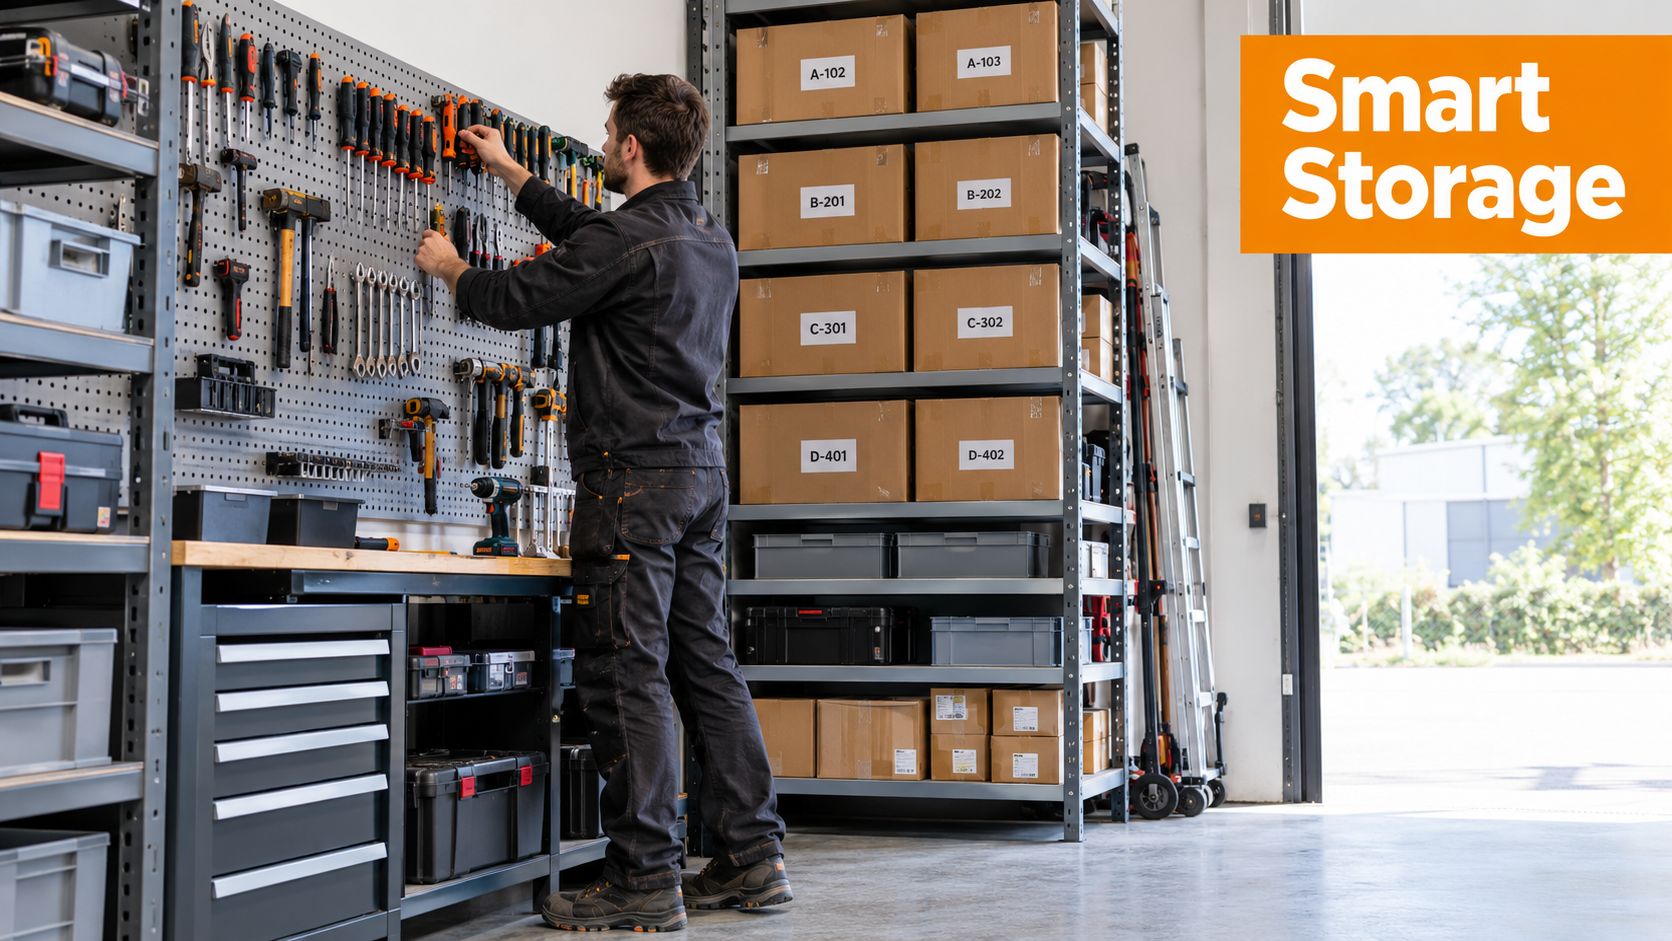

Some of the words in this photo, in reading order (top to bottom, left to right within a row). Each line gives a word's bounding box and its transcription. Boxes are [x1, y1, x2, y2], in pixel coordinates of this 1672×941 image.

[967, 56, 1001, 69] A-103
[810, 66, 846, 80] A-102
[967, 188, 1001, 200] B-202
[810, 195, 845, 208] B-201
[810, 322, 846, 335] C-301
[967, 316, 1003, 329] C-302
[810, 450, 847, 463] D-401
[968, 449, 1004, 461] D-402
